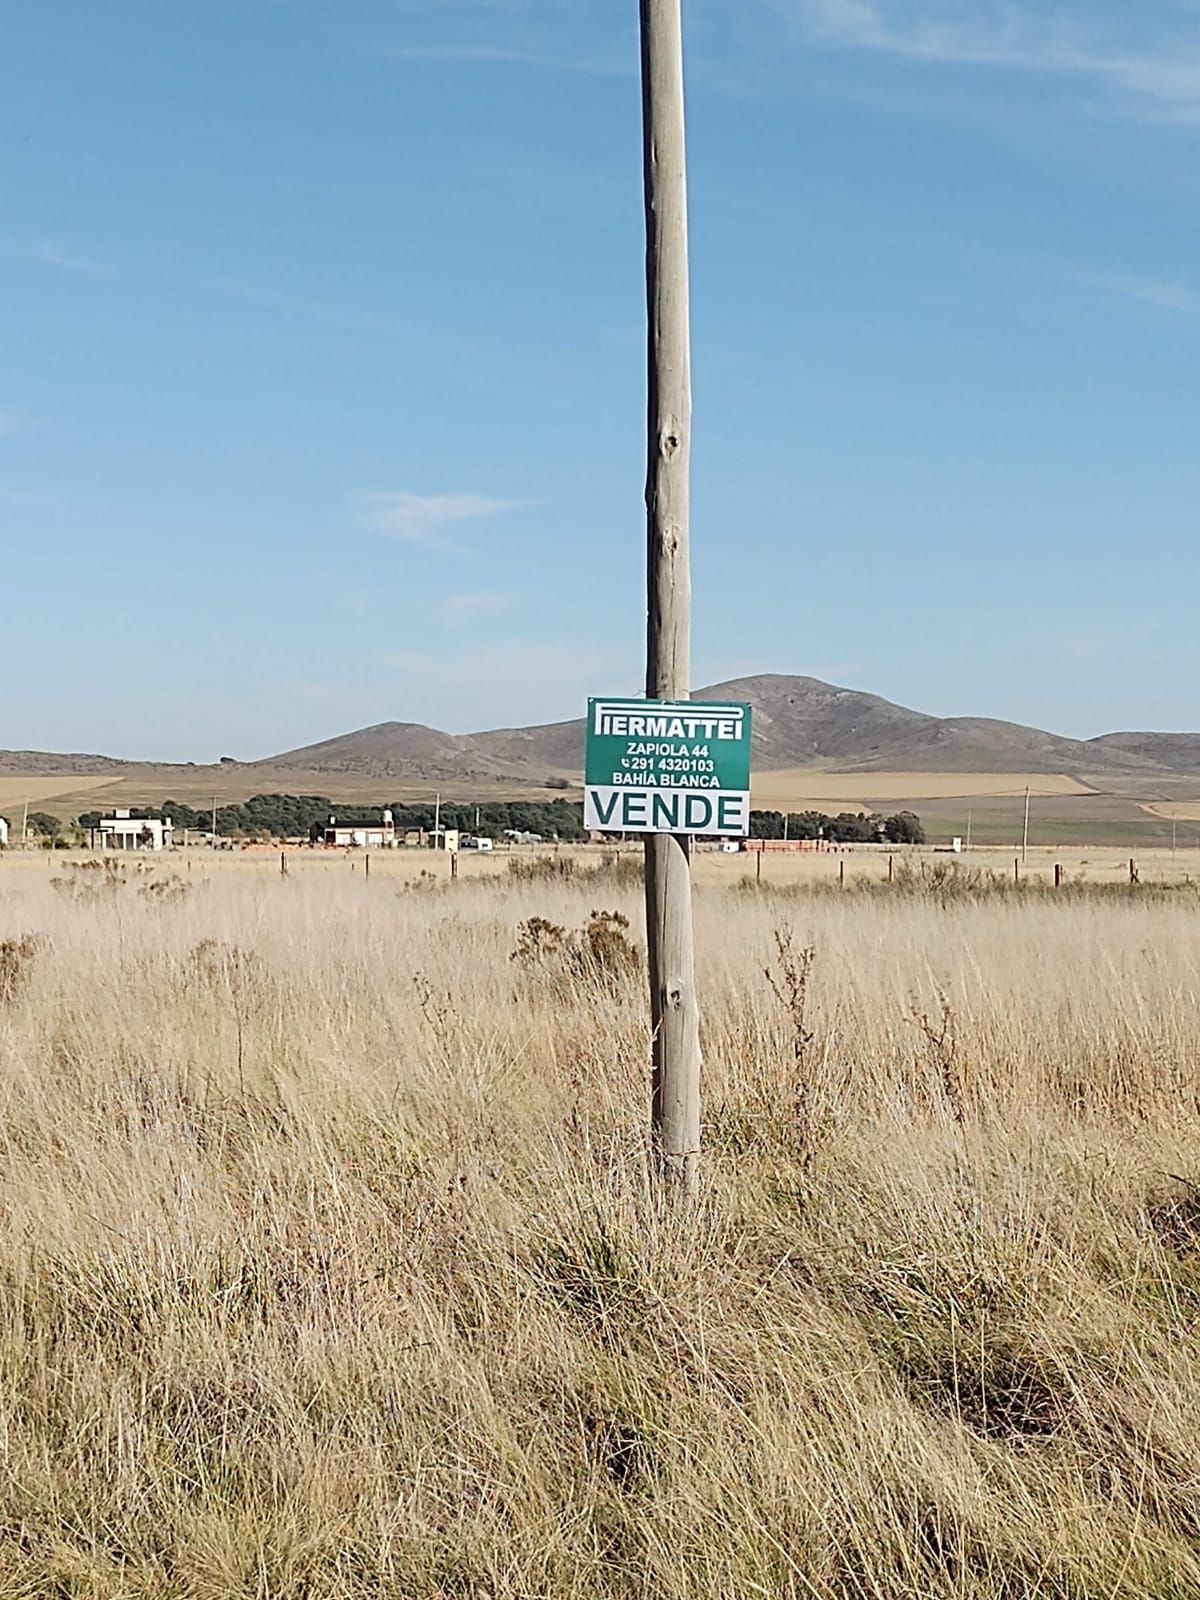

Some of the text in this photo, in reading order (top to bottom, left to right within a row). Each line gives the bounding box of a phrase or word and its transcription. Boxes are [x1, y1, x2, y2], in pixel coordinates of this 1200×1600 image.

[594, 703, 744, 740] PIERMATTEI
[627, 742, 709, 757] ZAPIOLA 44
[631, 758, 714, 772] 291 4320103
[612, 770, 720, 788] BAHÍA BLANCA
[590, 791, 743, 830] VENDE
